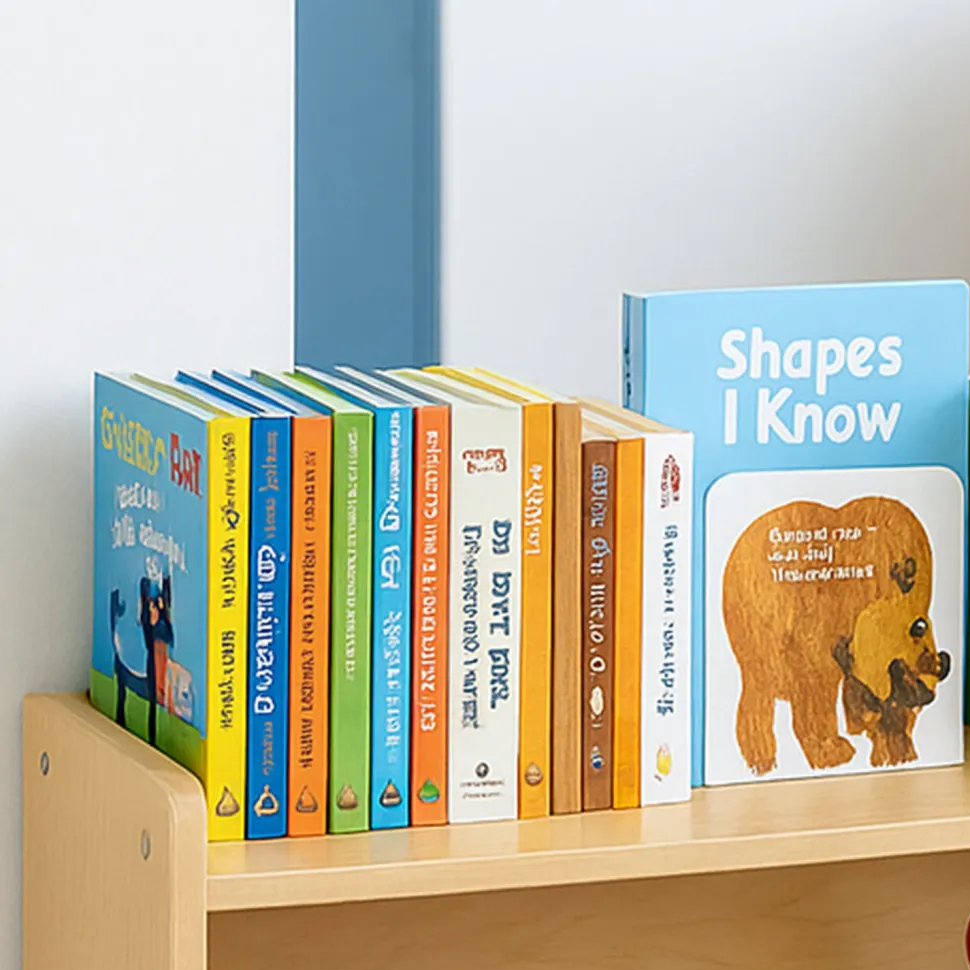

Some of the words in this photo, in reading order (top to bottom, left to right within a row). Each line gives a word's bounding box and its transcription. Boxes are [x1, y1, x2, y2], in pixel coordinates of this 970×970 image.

[716, 326, 902, 395] Shapes
[724, 388, 738, 445] I
[757, 387, 901, 444] Know
